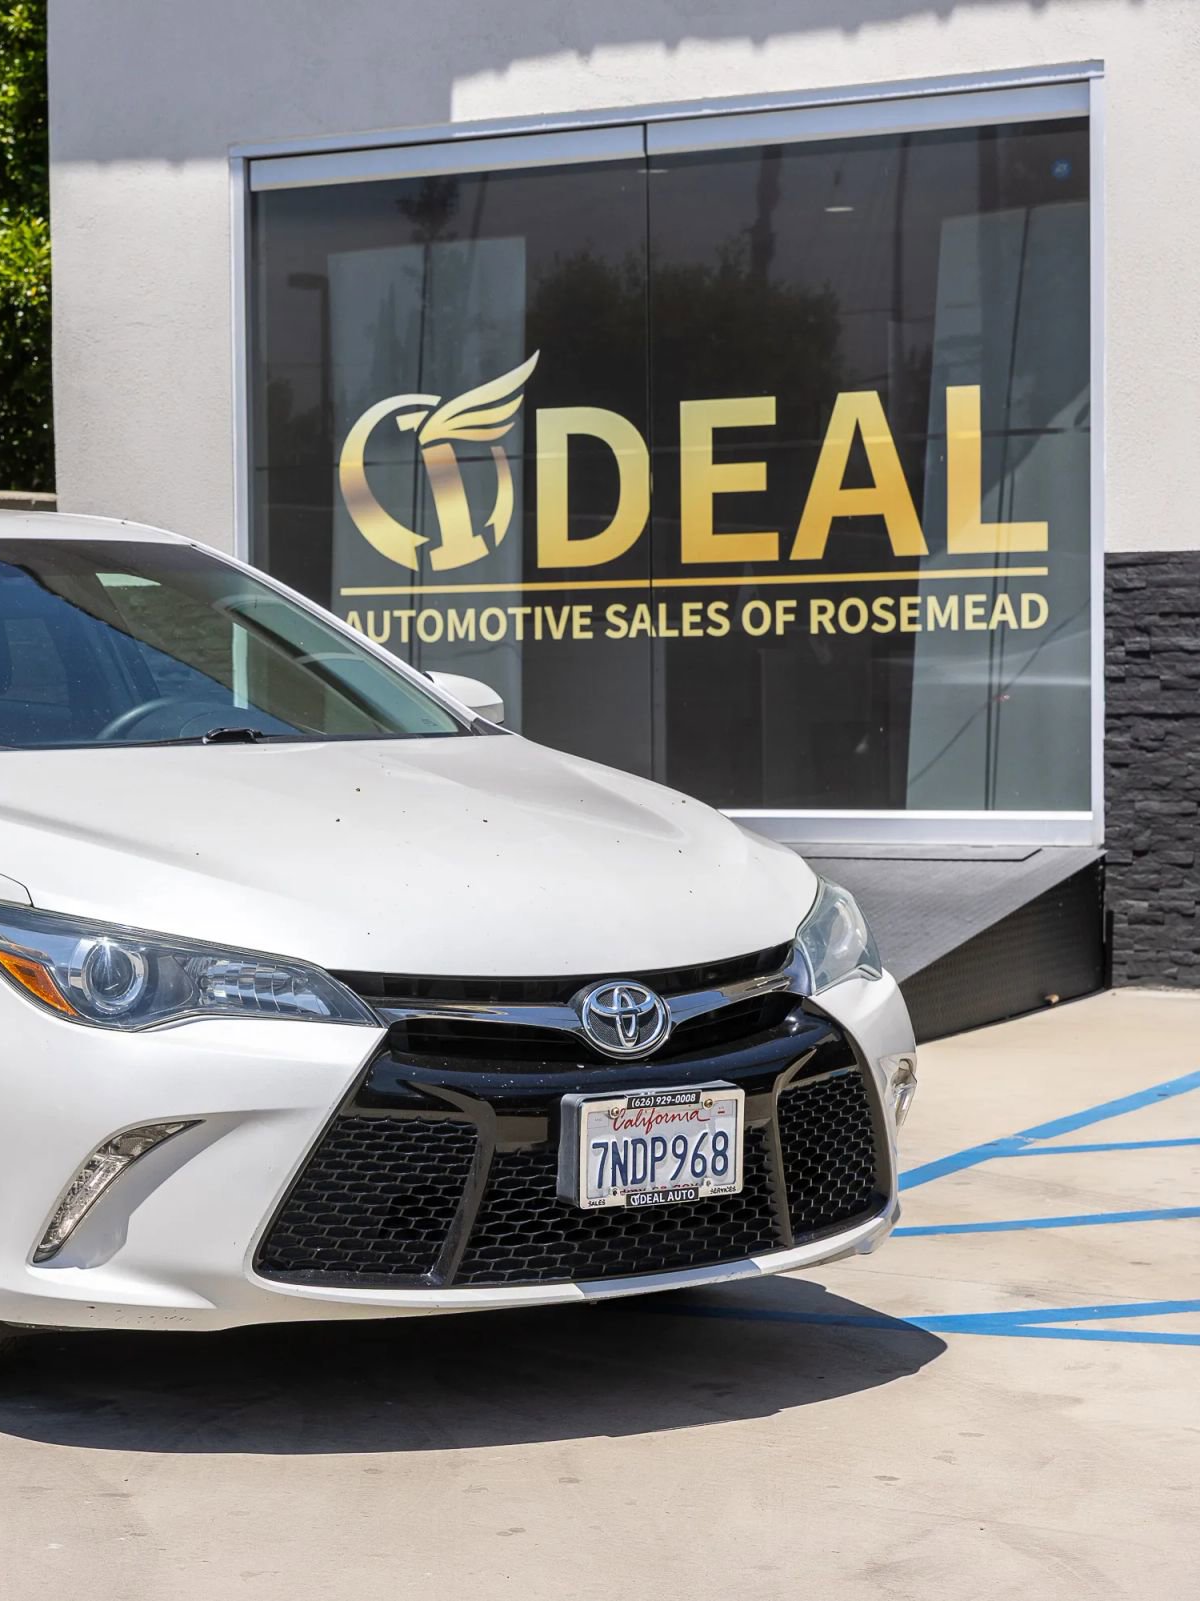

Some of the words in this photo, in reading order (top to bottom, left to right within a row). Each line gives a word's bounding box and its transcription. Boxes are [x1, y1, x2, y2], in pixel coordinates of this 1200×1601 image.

[345, 604, 593, 643] AUTOMOTIVE
[605, 601, 730, 640] SALES
[741, 599, 797, 637] OF
[810, 592, 1049, 635] ROSEMEAD
[631, 1096, 654, 1108] (626)
[656, 1093, 696, 1105] 929-0008
[612, 1104, 710, 1135] California
[591, 1130, 729, 1189] 7NDP968
[667, 1189, 695, 1202] AUTO
